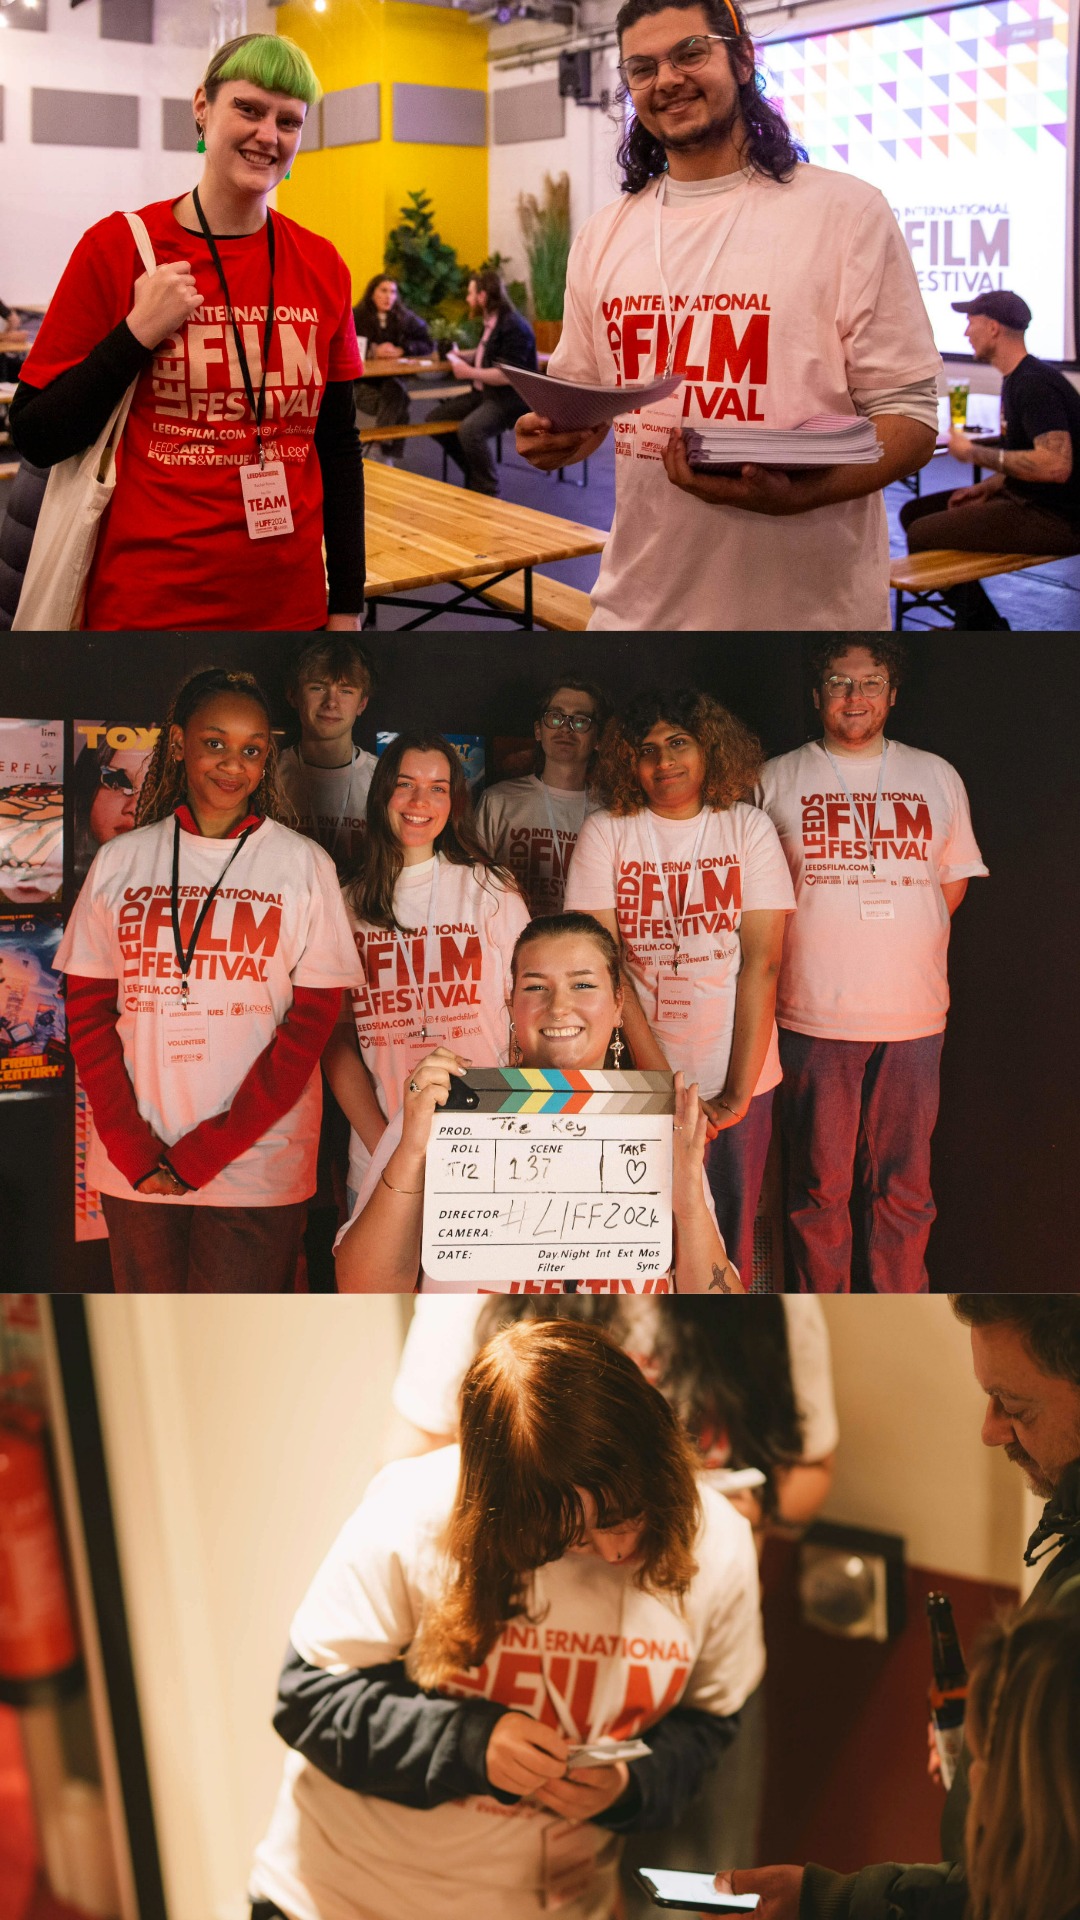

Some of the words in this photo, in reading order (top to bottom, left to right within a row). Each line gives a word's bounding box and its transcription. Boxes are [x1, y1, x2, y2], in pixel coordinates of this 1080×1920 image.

[904, 218, 1010, 266] FILM
[187, 323, 323, 389] FILM
[622, 314, 770, 385] FILM
[153, 422, 247, 441] LEEDSFILM.COM
[248, 495, 287, 512] TEAM
[255, 518, 287, 528] #LIFF2024
[41, 727, 56, 737] lim
[801, 793, 826, 860] LEEDS
[826, 802, 933, 841] FILM
[828, 839, 929, 861] FESTIVAL
[617, 860, 642, 939] LEEDS
[641, 866, 742, 918] FILM
[118, 886, 152, 978] LEEDS
[143, 897, 282, 957] FILM
[142, 951, 268, 983] FESTIVAL
[366, 936, 483, 990] FILM
[167, 1038, 206, 1047] VOLUNTEER
[439, 1126, 473, 1137] PROD.
[551, 1117, 587, 1136] Key
[450, 1144, 480, 1153] ROLL
[529, 1144, 564, 1154] SCENE
[618, 1143, 648, 1155] TAKE
[438, 1209, 500, 1220] DIRECTOR
[437, 1228, 494, 1239] CAMERA:
[436, 1250, 473, 1261] DATE:
[595, 1249, 611, 1259] Int
[617, 1249, 634, 1259] Ext
[638, 1249, 660, 1259] Mos
[537, 1263, 566, 1273] Filter
[636, 1262, 660, 1273] Sync
[502, 1624, 690, 1662] INTERNATIONAL
